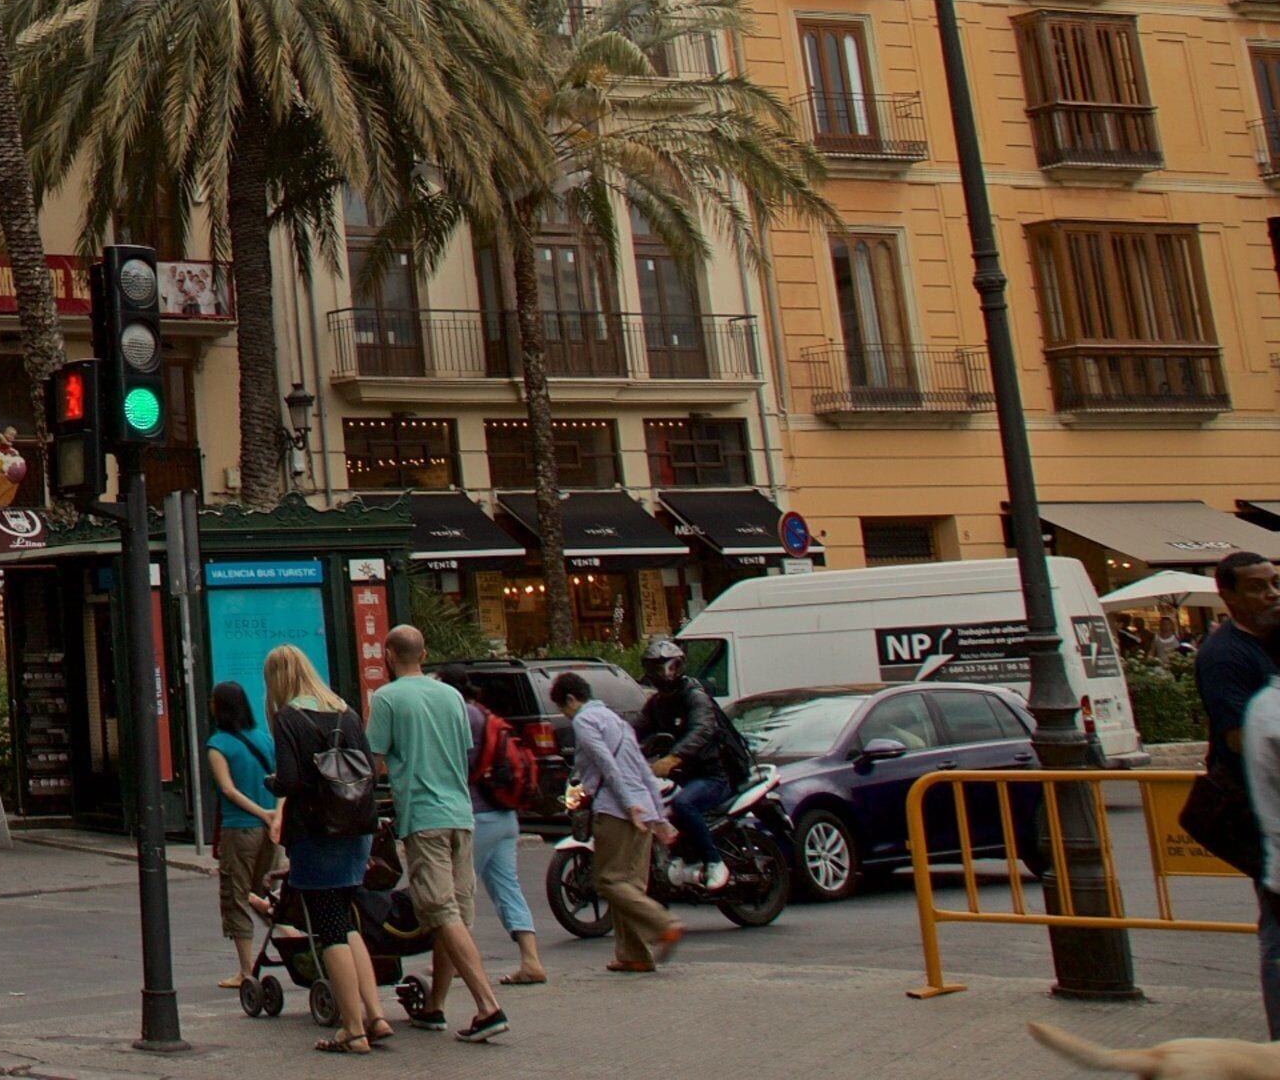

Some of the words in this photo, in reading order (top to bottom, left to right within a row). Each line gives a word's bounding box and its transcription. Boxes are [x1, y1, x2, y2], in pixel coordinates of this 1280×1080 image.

[211, 569, 256, 579] VALENCIA
[256, 568, 276, 578] BUS
[276, 567, 317, 578] TURISTIC
[885, 633, 932, 661] NP
